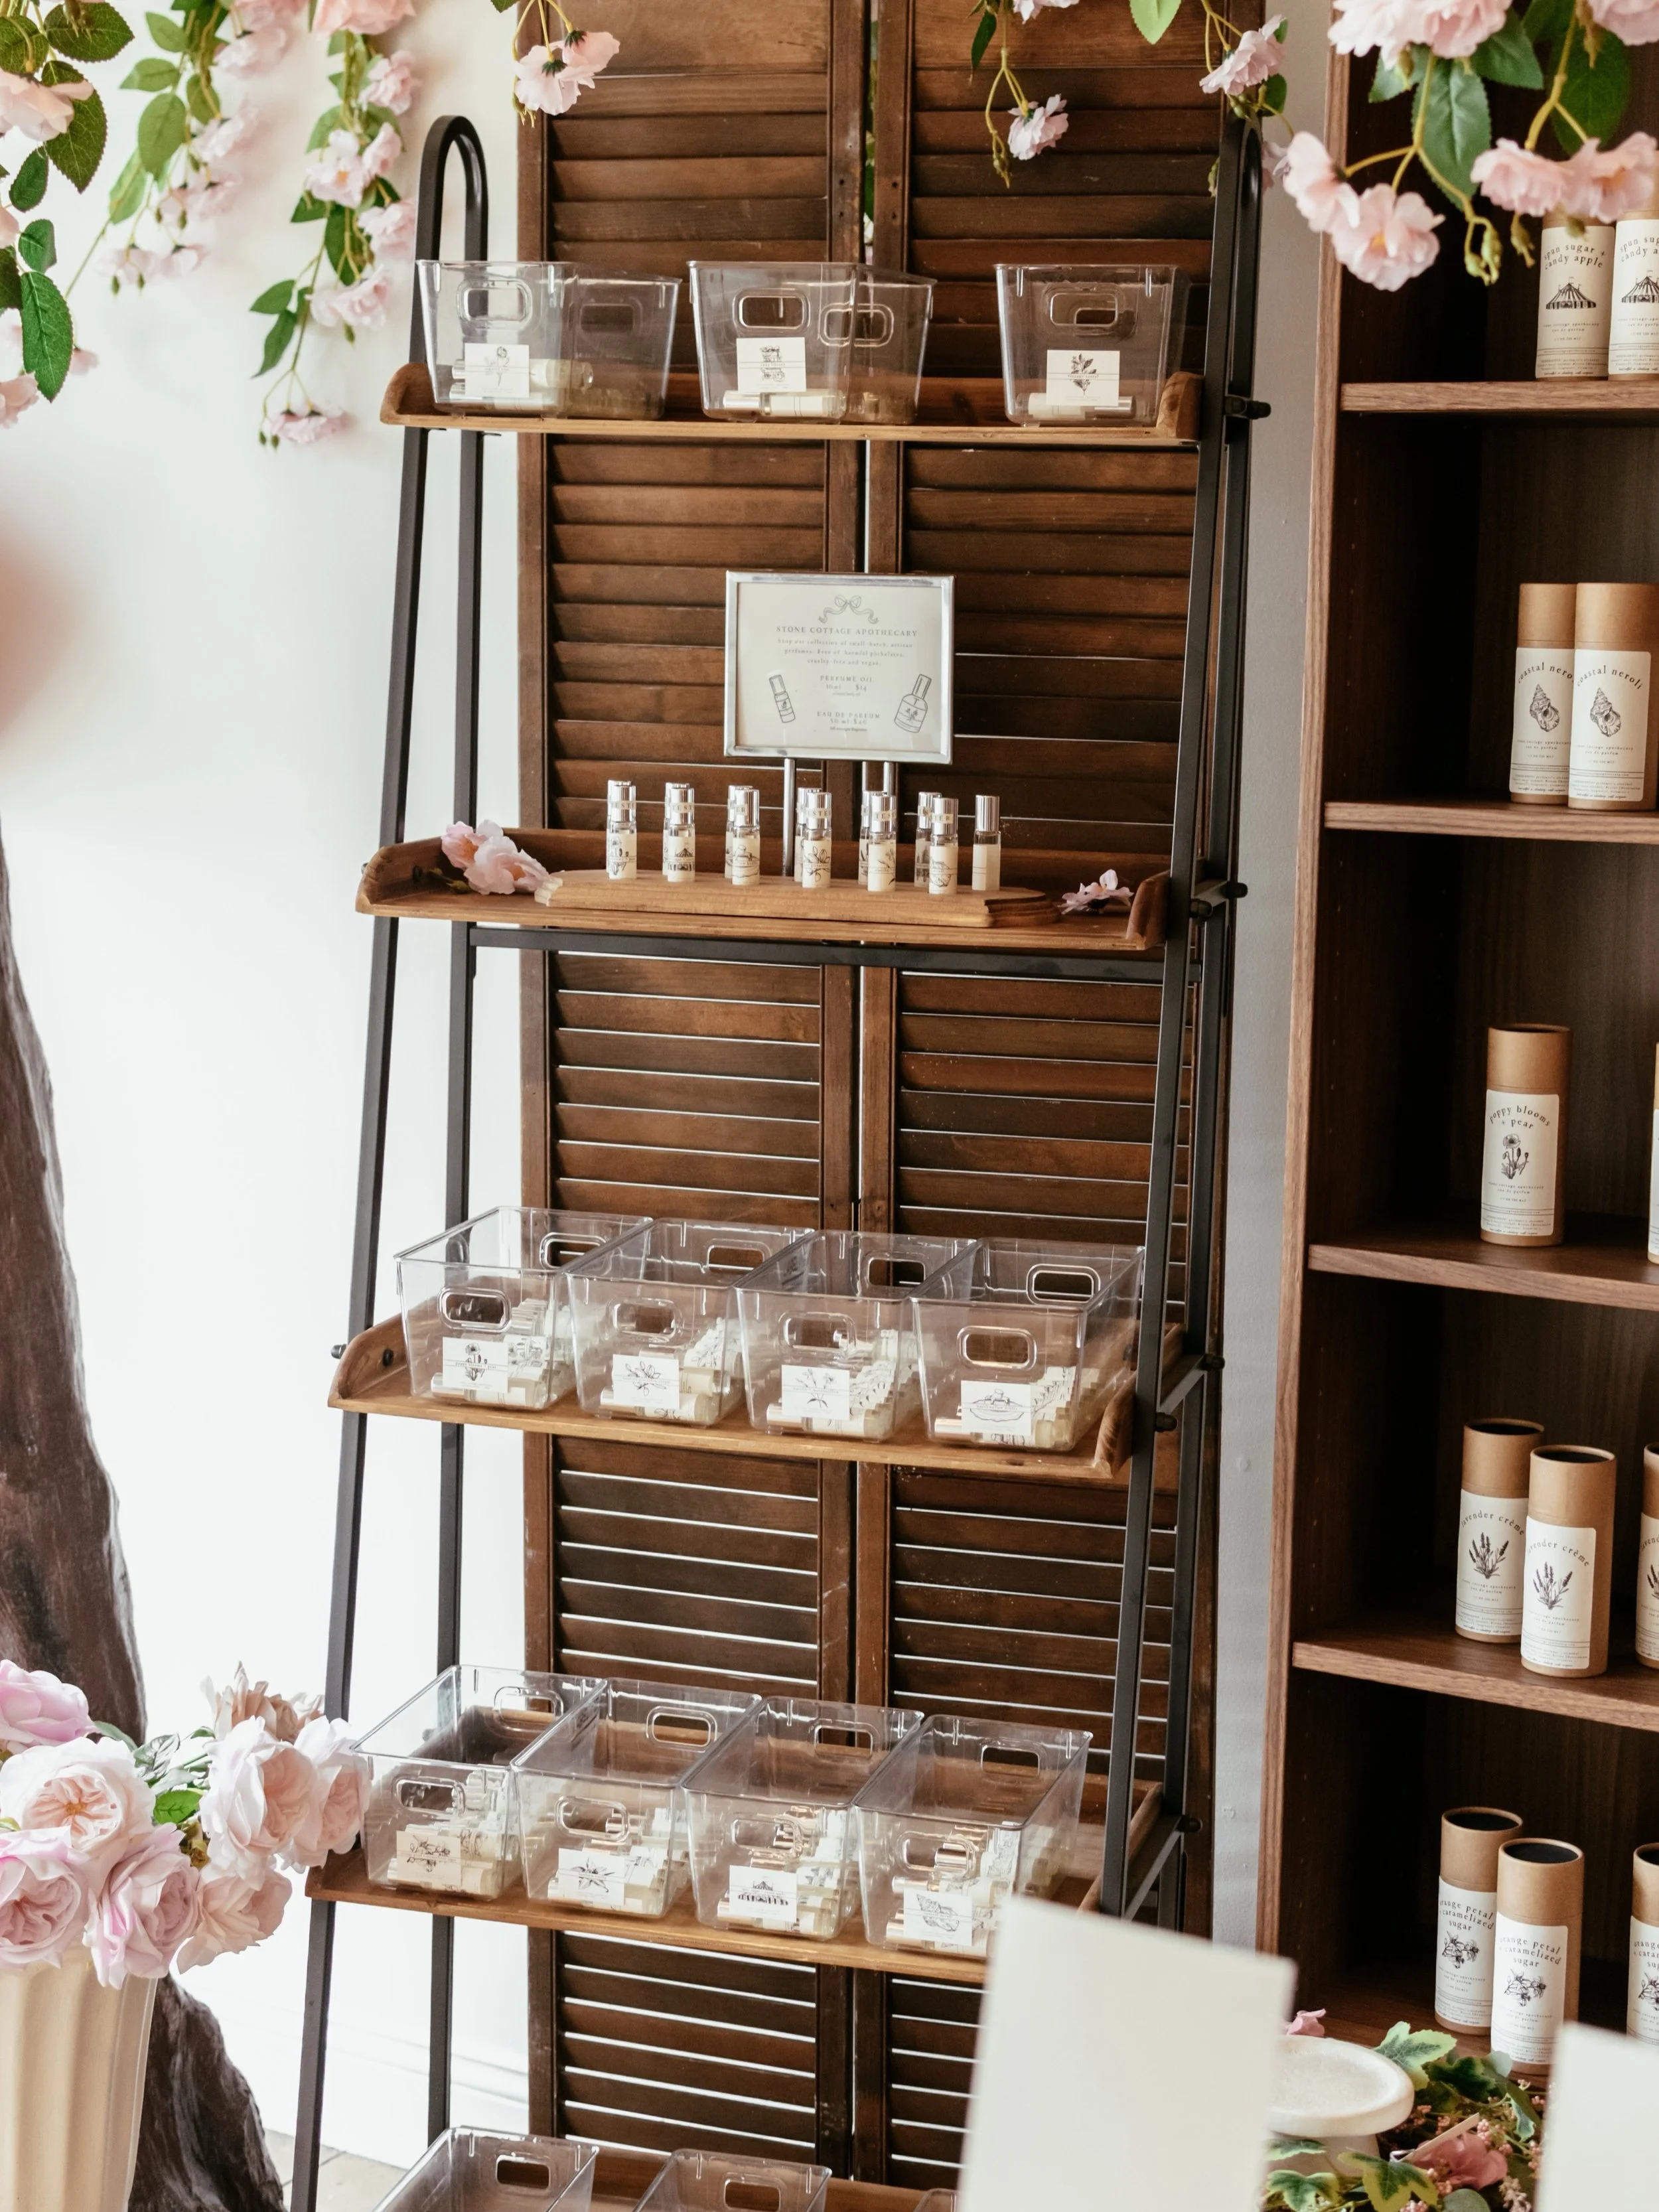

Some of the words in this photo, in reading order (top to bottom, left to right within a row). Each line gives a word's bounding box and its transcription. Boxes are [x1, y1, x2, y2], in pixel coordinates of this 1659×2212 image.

[1544, 246, 1560, 260] spun
[1565, 244, 1595, 254] sugar
[1620, 238, 1639, 253] spun
[1621, 246, 1648, 262] candy
[1545, 254, 1569, 270] candy
[1574, 256, 1603, 268] apple
[810, 627, 851, 635] COTTAGE
[855, 628, 918, 637] APOTHECARY
[1518, 661, 1545, 684] coastal
[1577, 664, 1606, 688] coastal
[1611, 669, 1644, 690] neroli
[1489, 1106, 1512, 1125] poppy
[1516, 1104, 1551, 1127] blooms
[1510, 1118, 1534, 1130] pear
[1460, 1509, 1494, 1529] lavender
[1439, 1899, 1462, 1910] orange
[1465, 1905, 1494, 1921] petal
[1442, 1909, 1494, 1931] caramelized
[1449, 1920, 1473, 1932] sugar
[1499, 1937, 1528, 1947] orange
[1532, 1941, 1561, 1955] petal
[1504, 1947, 1561, 1965] caramelized
[1513, 1957, 1540, 1968] sugar
